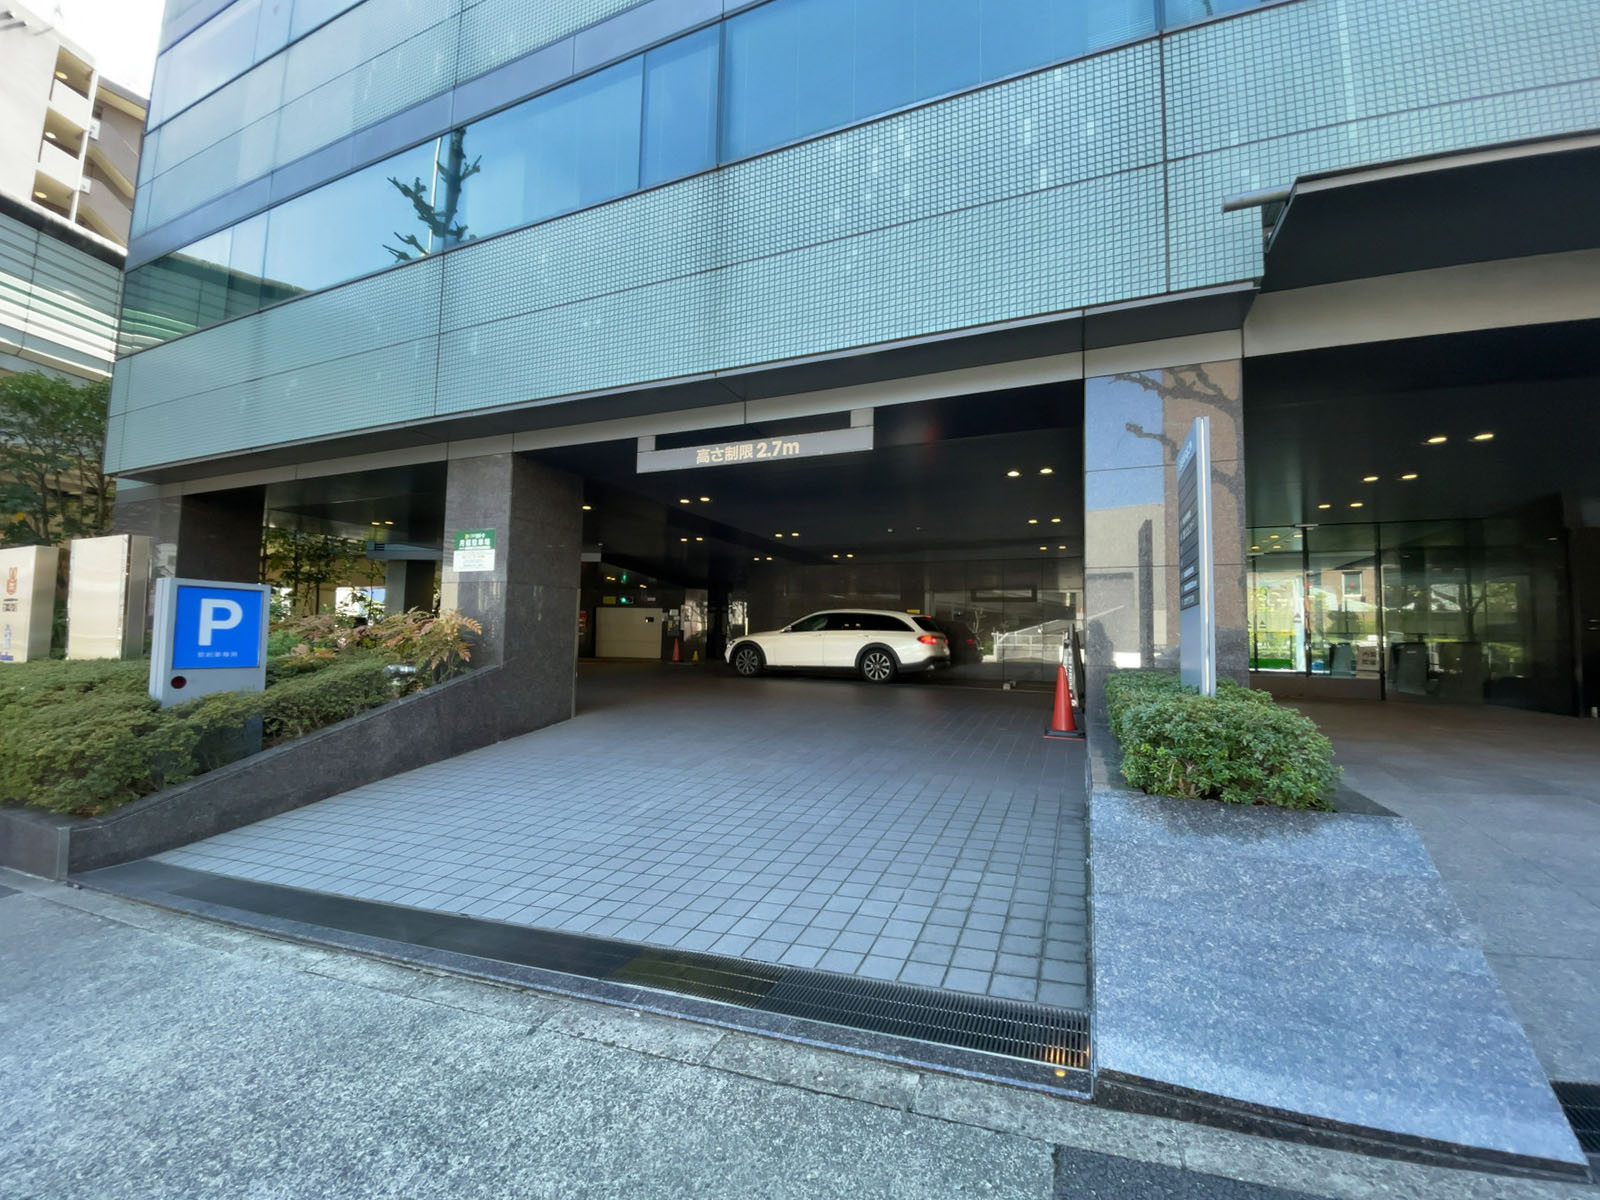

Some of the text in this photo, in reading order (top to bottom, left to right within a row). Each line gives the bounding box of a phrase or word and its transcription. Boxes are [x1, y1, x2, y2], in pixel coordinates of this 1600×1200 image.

[696, 440, 800, 464] 高さ制限 2.7m
[198, 598, 243, 646] P
